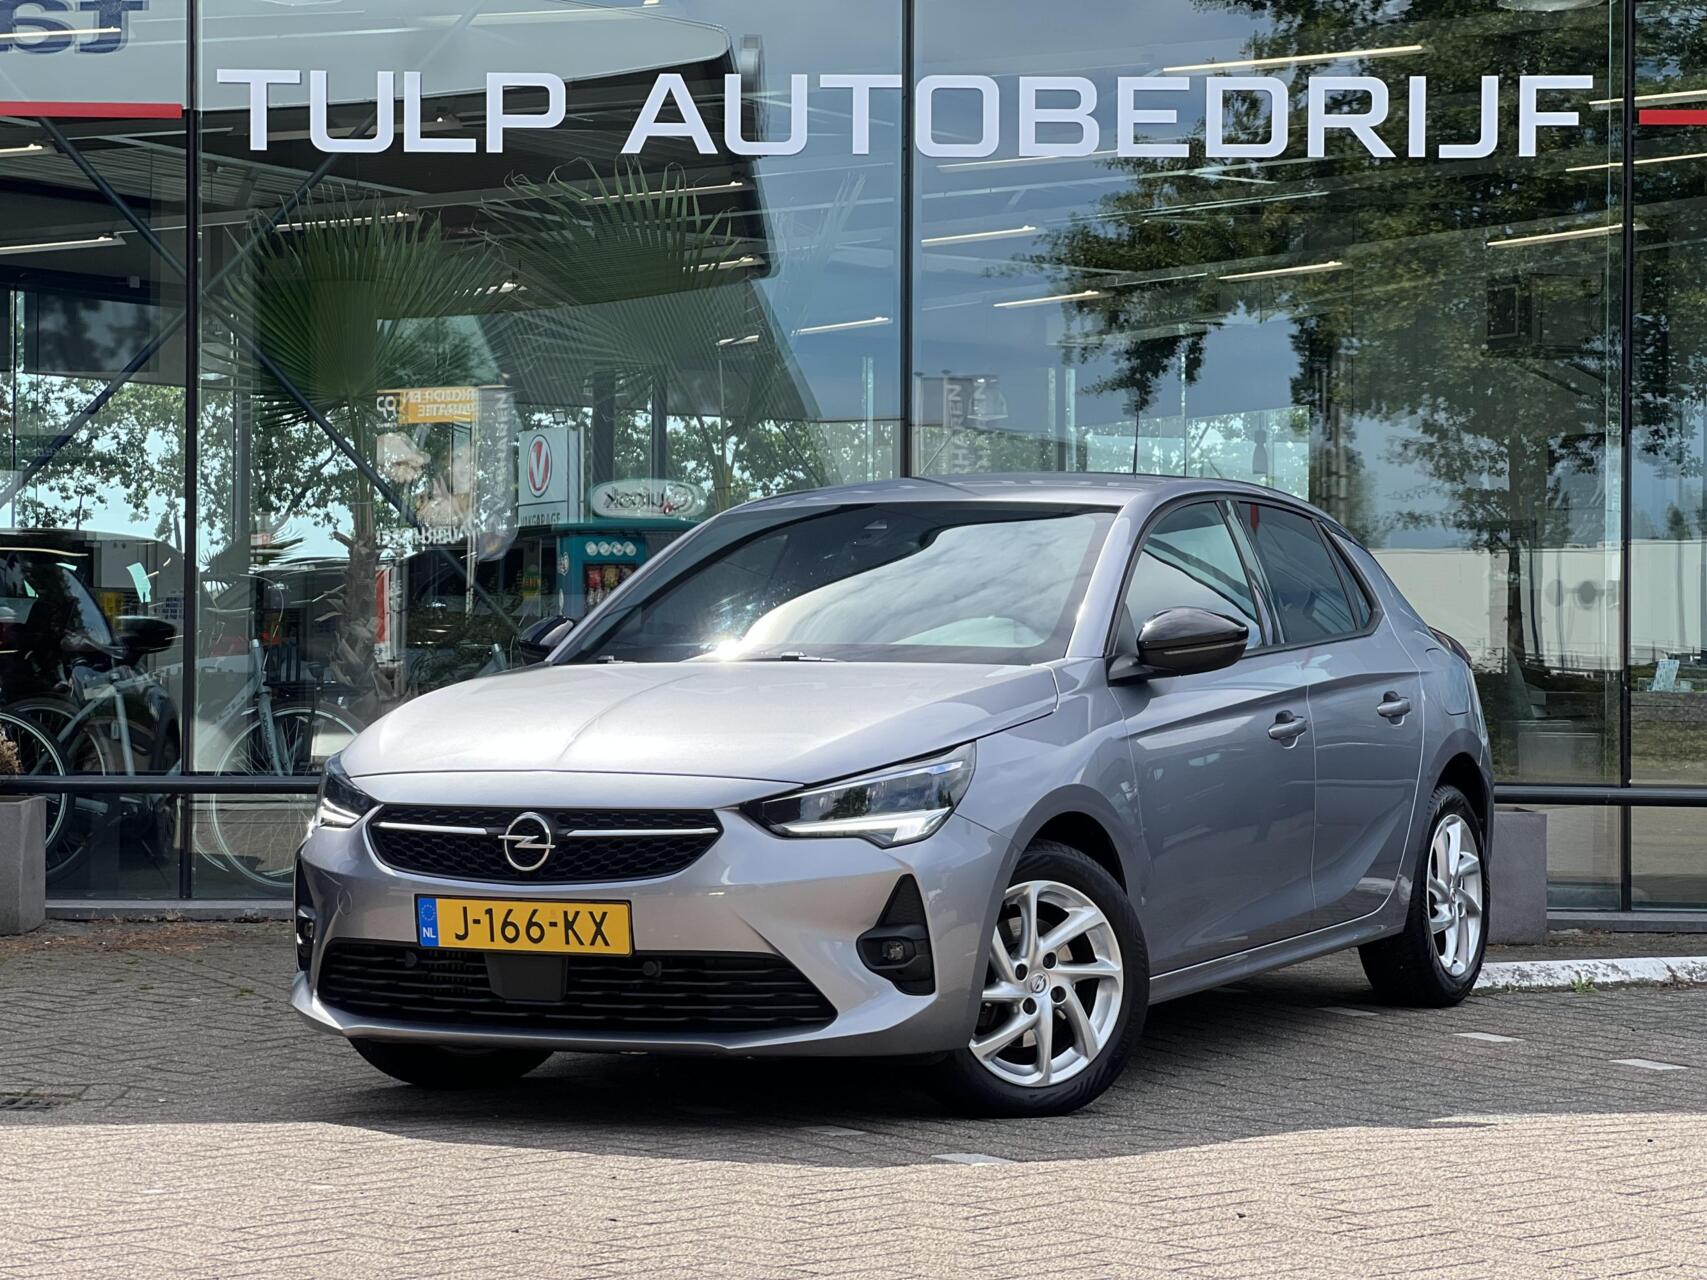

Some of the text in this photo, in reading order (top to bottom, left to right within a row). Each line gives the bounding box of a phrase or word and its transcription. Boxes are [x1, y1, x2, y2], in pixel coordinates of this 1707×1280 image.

[216, 68, 1593, 159] TULP AUTOBEDRIJF
[422, 927, 437, 939] NL
[454, 906, 610, 947] J-166-KX
